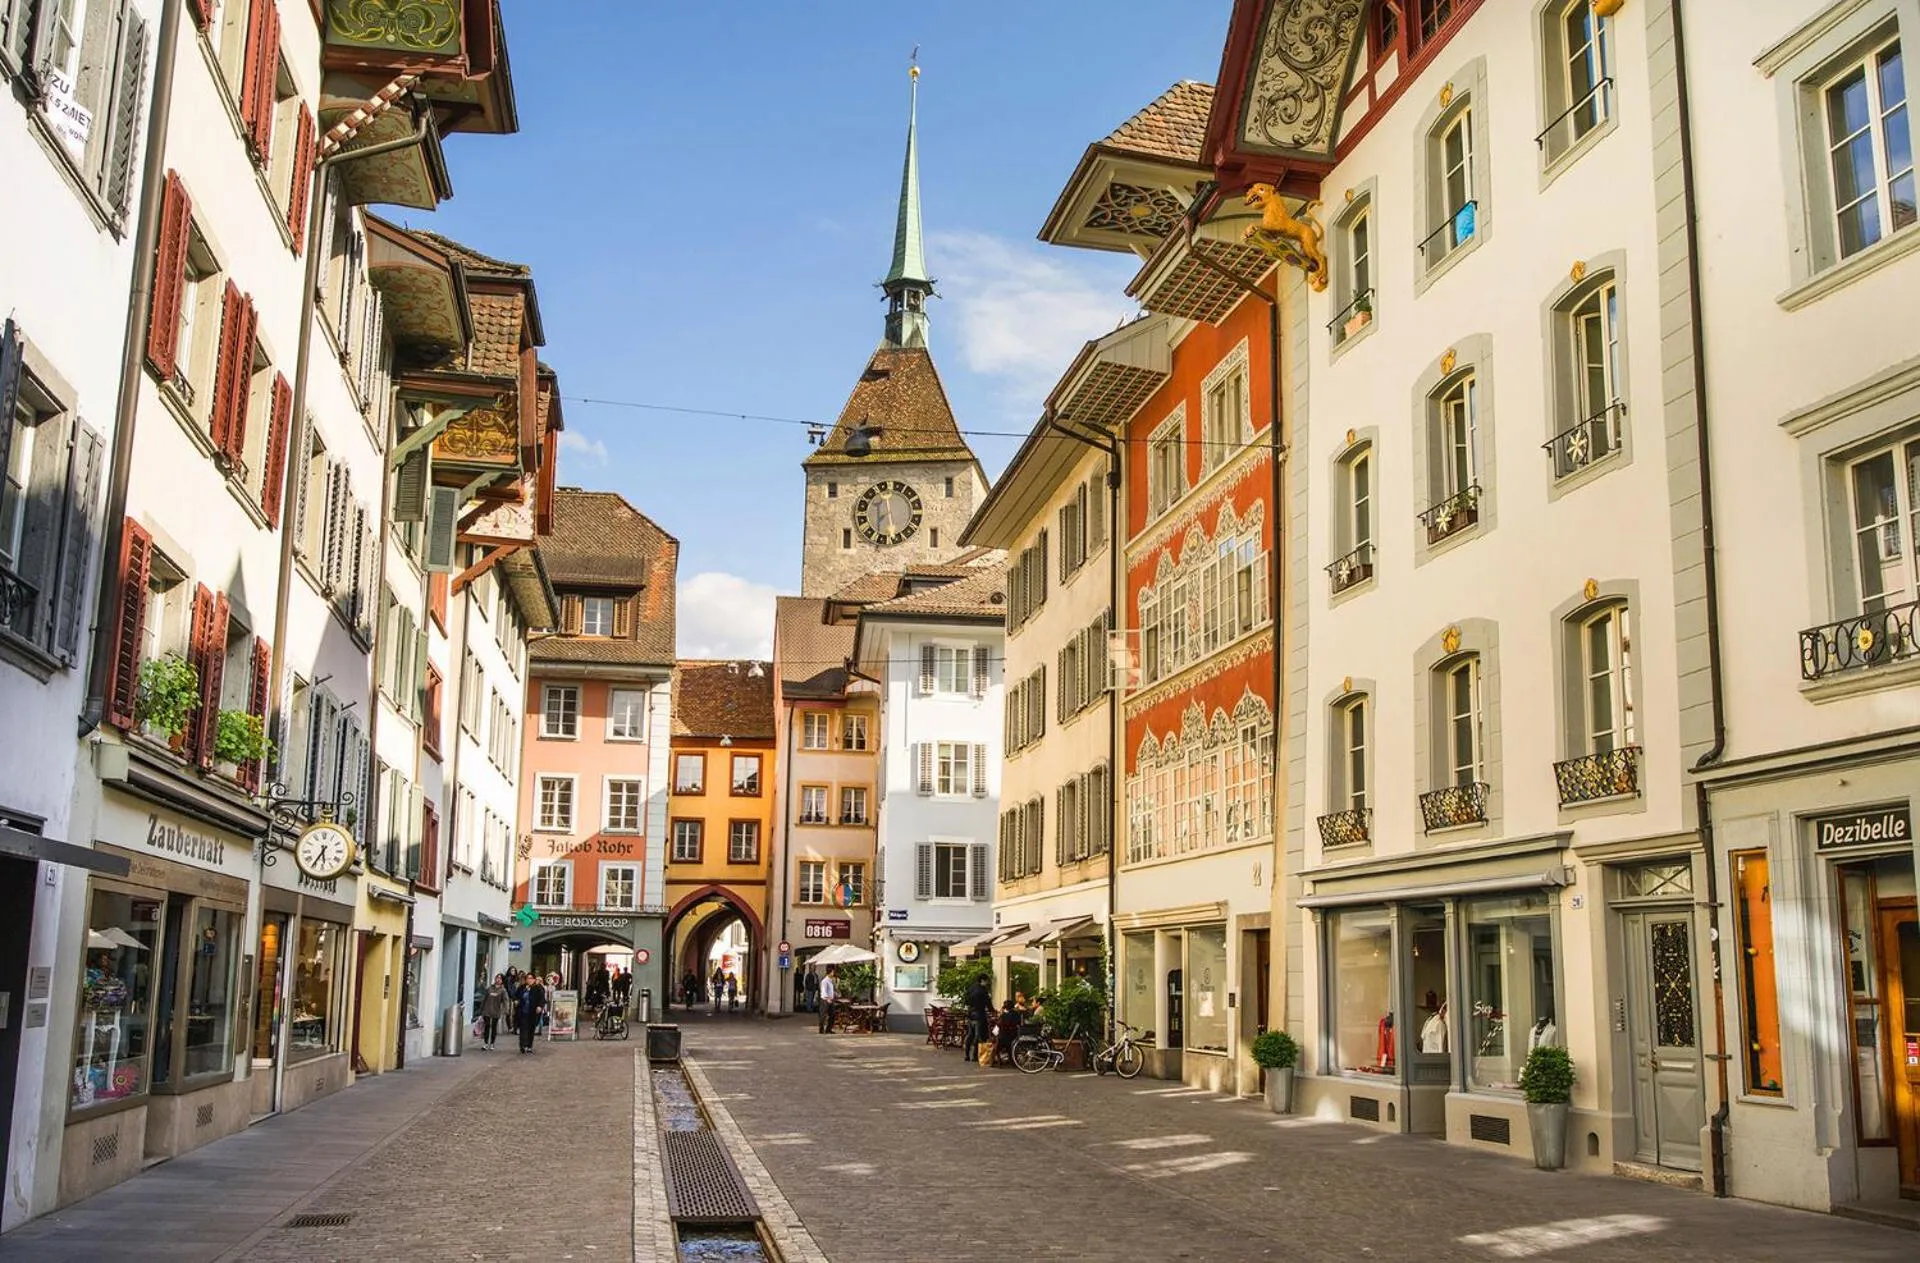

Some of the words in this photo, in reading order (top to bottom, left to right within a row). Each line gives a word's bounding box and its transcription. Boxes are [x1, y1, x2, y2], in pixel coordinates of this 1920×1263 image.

[51, 74, 70, 94] ZU
[146, 811, 225, 866] Zauberhaft
[1822, 814, 1906, 845] Dezibelle
[596, 839, 634, 856] Rohr
[540, 917, 563, 927] THE
[564, 918, 596, 927] BODY
[597, 918, 628, 928] SHOP
[806, 925, 833, 938] 0816
